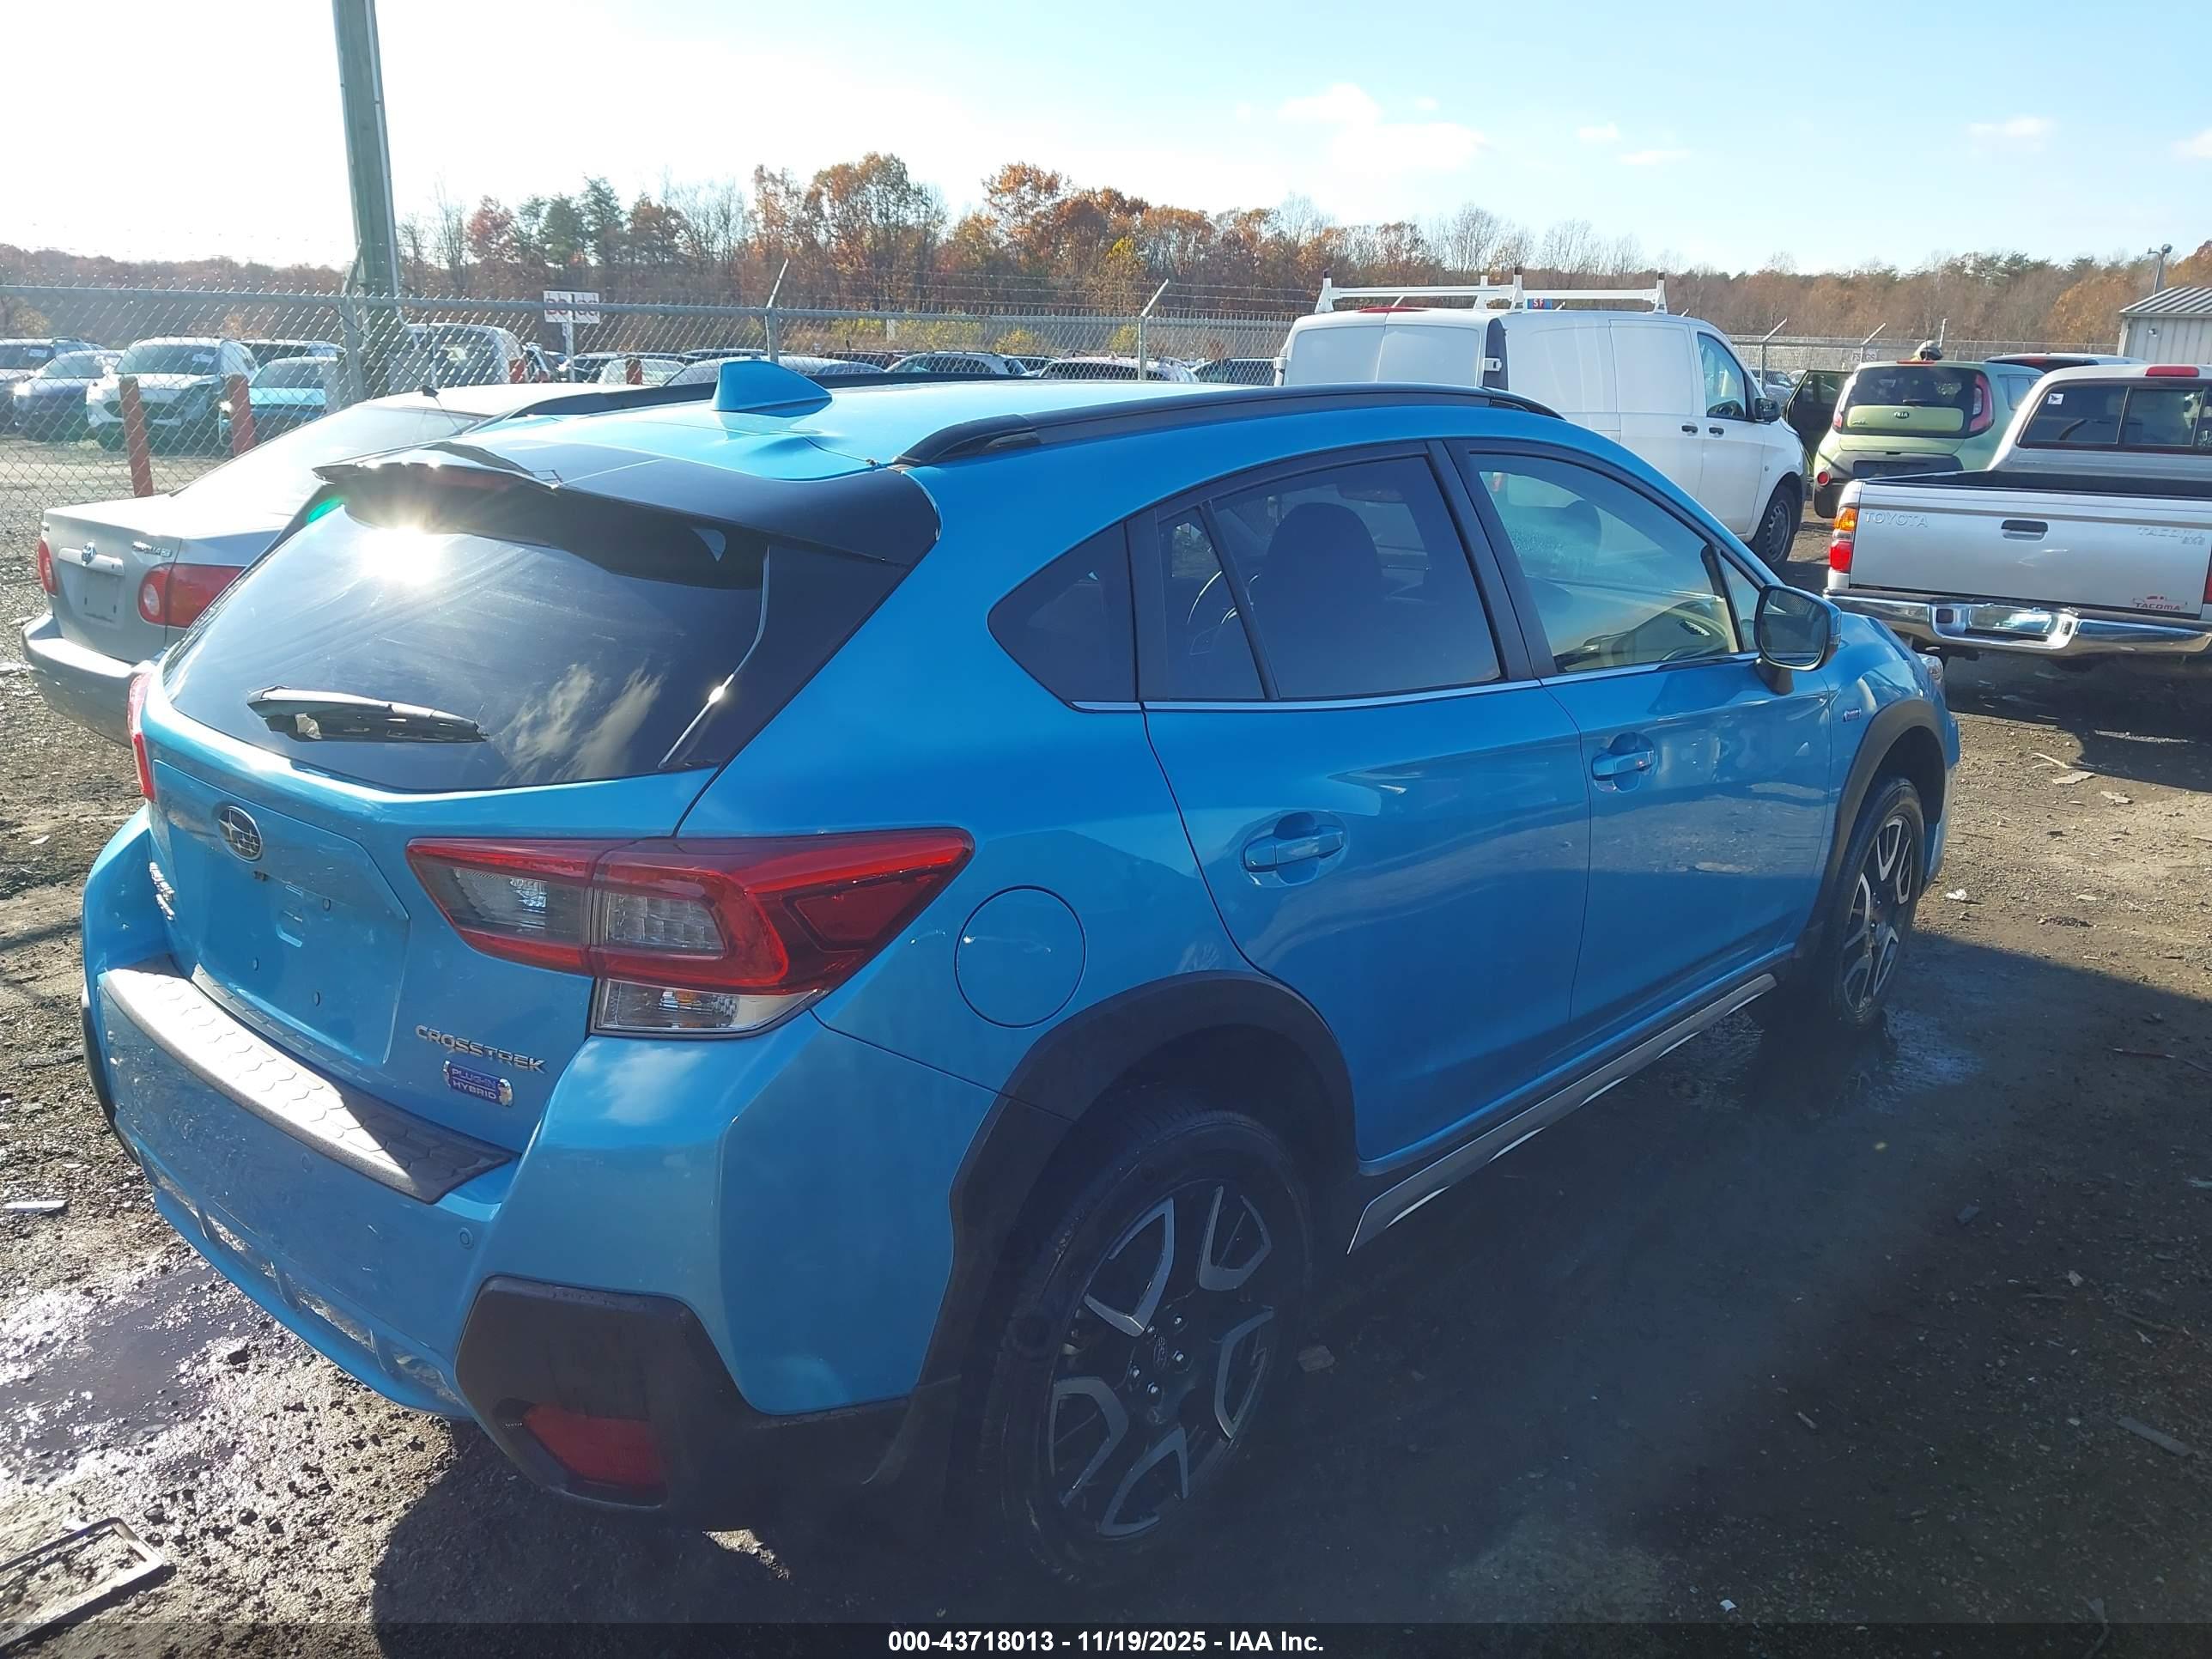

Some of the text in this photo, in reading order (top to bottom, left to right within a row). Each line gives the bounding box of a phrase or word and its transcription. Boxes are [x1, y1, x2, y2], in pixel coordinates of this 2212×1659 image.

[1864, 512, 1929, 528] TOYOTA
[2135, 602, 2181, 611] TACOMA
[415, 1024, 547, 1073] CROSSTREK
[452, 1067, 496, 1089] PLUG-IN
[453, 1079, 497, 1100] HYBRID
